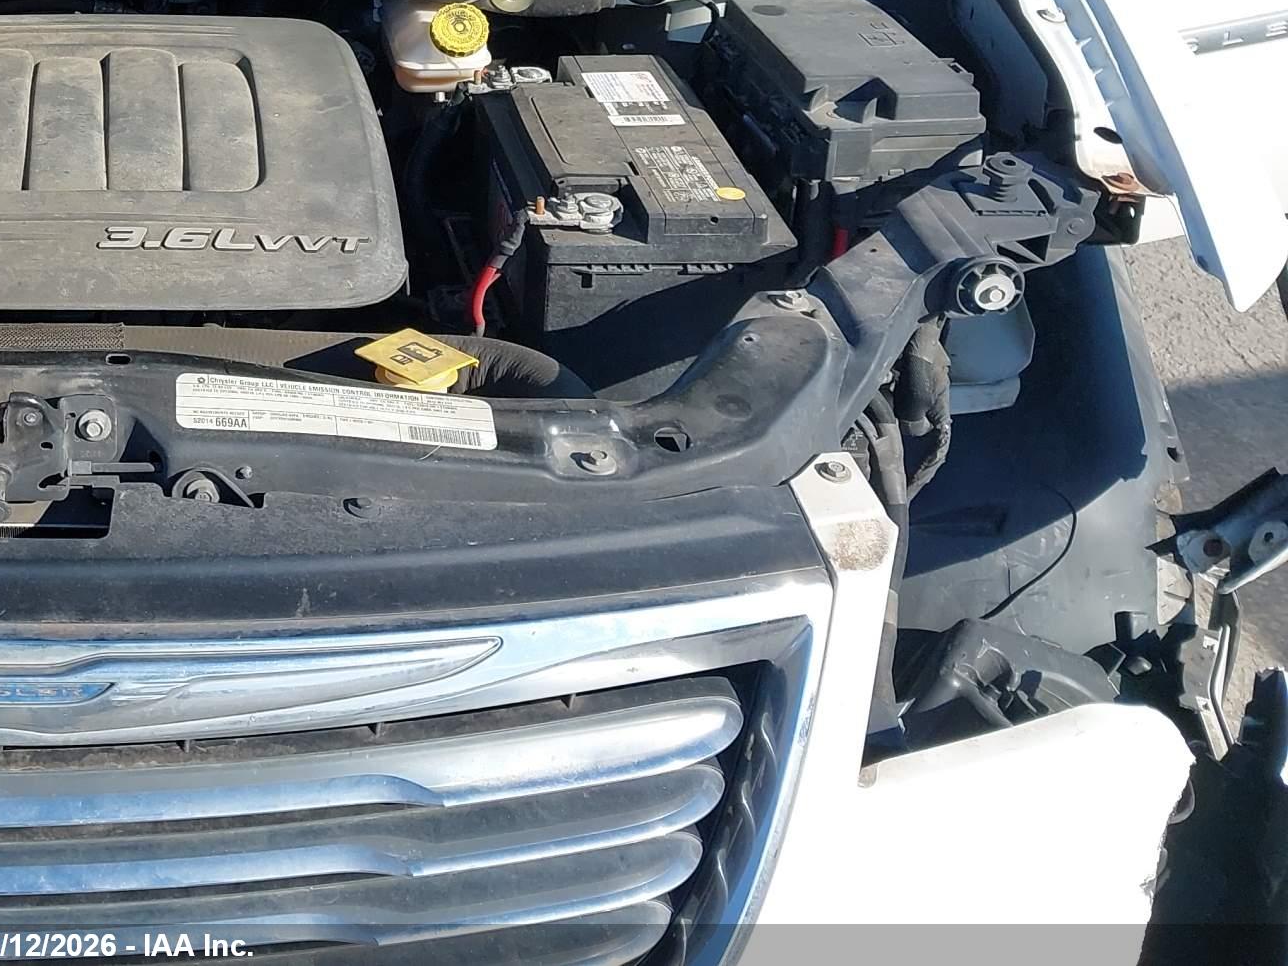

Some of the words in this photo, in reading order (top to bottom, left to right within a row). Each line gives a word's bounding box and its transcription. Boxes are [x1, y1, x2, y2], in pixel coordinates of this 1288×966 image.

[209, 377, 237, 385] Chrysler
[239, 379, 260, 387] Group
[279, 383, 307, 391] VEHICLE
[308, 386, 340, 394] EMISSION
[341, 388, 372, 397] CONTROL
[373, 392, 420, 402] INFORMATION
